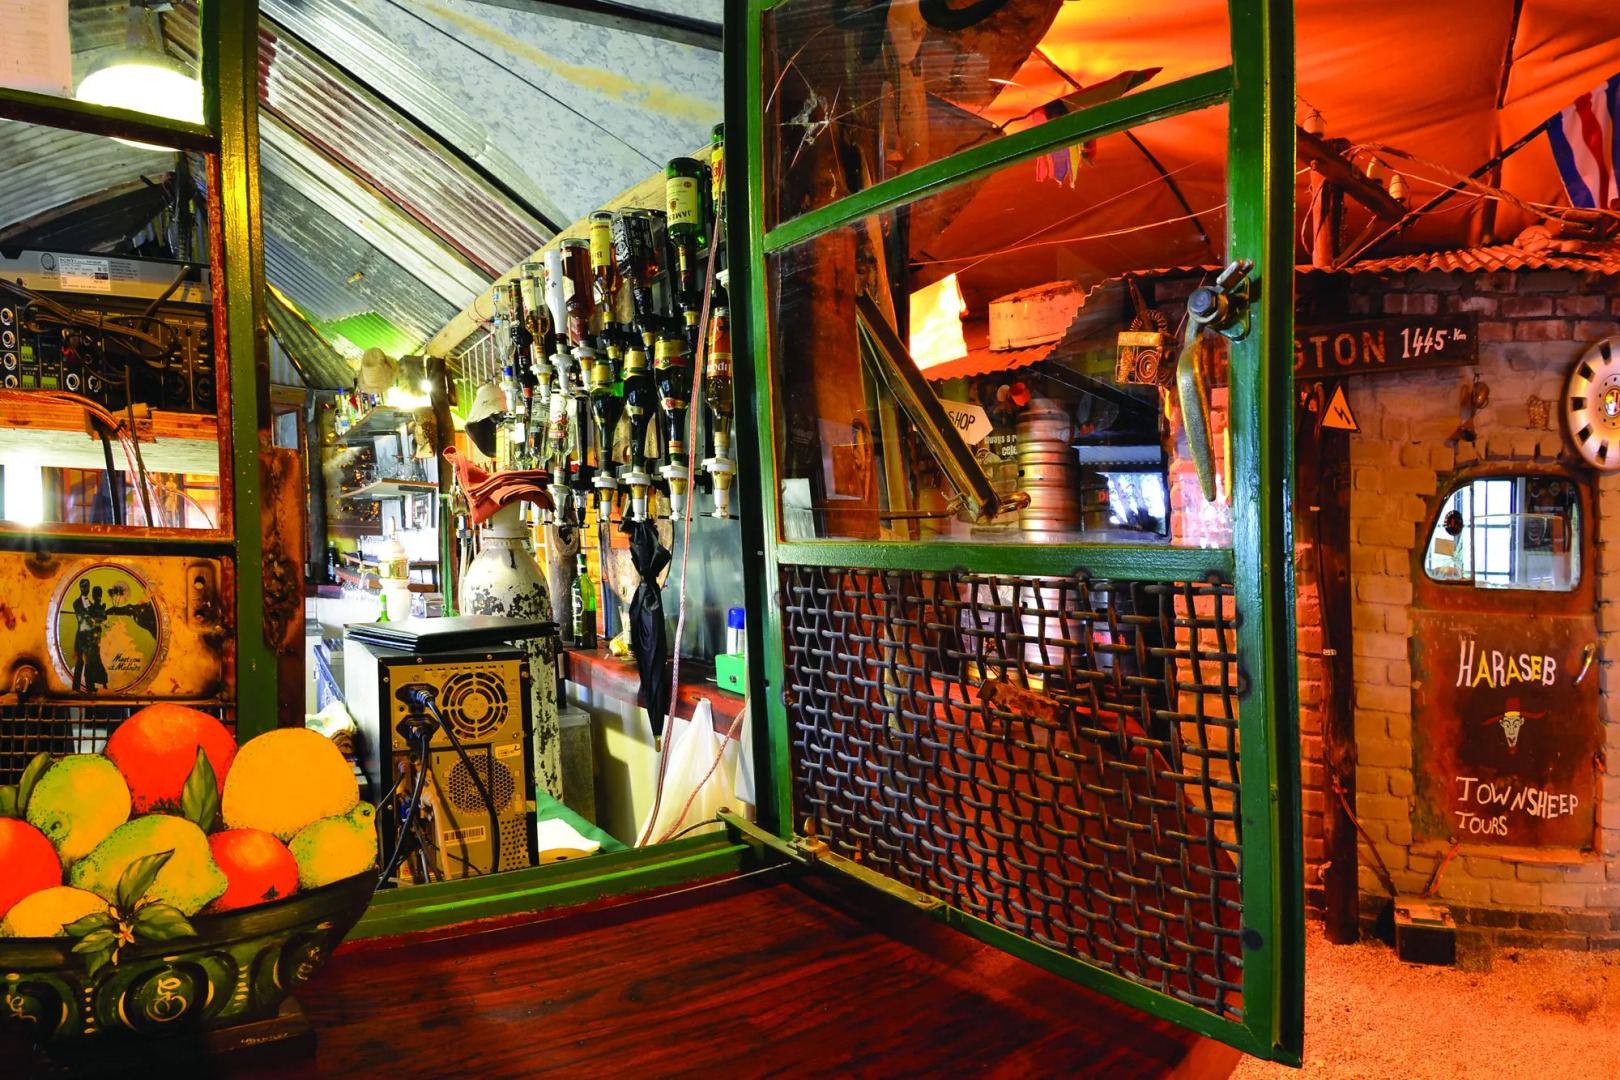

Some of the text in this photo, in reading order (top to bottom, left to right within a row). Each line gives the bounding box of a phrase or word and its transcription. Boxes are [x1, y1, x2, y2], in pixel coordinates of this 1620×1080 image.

[1400, 326, 1448, 358] 1445
[948, 410, 976, 432] SHOP
[1456, 640, 1557, 689] HARASEB
[1455, 811, 1508, 836] TOURS
